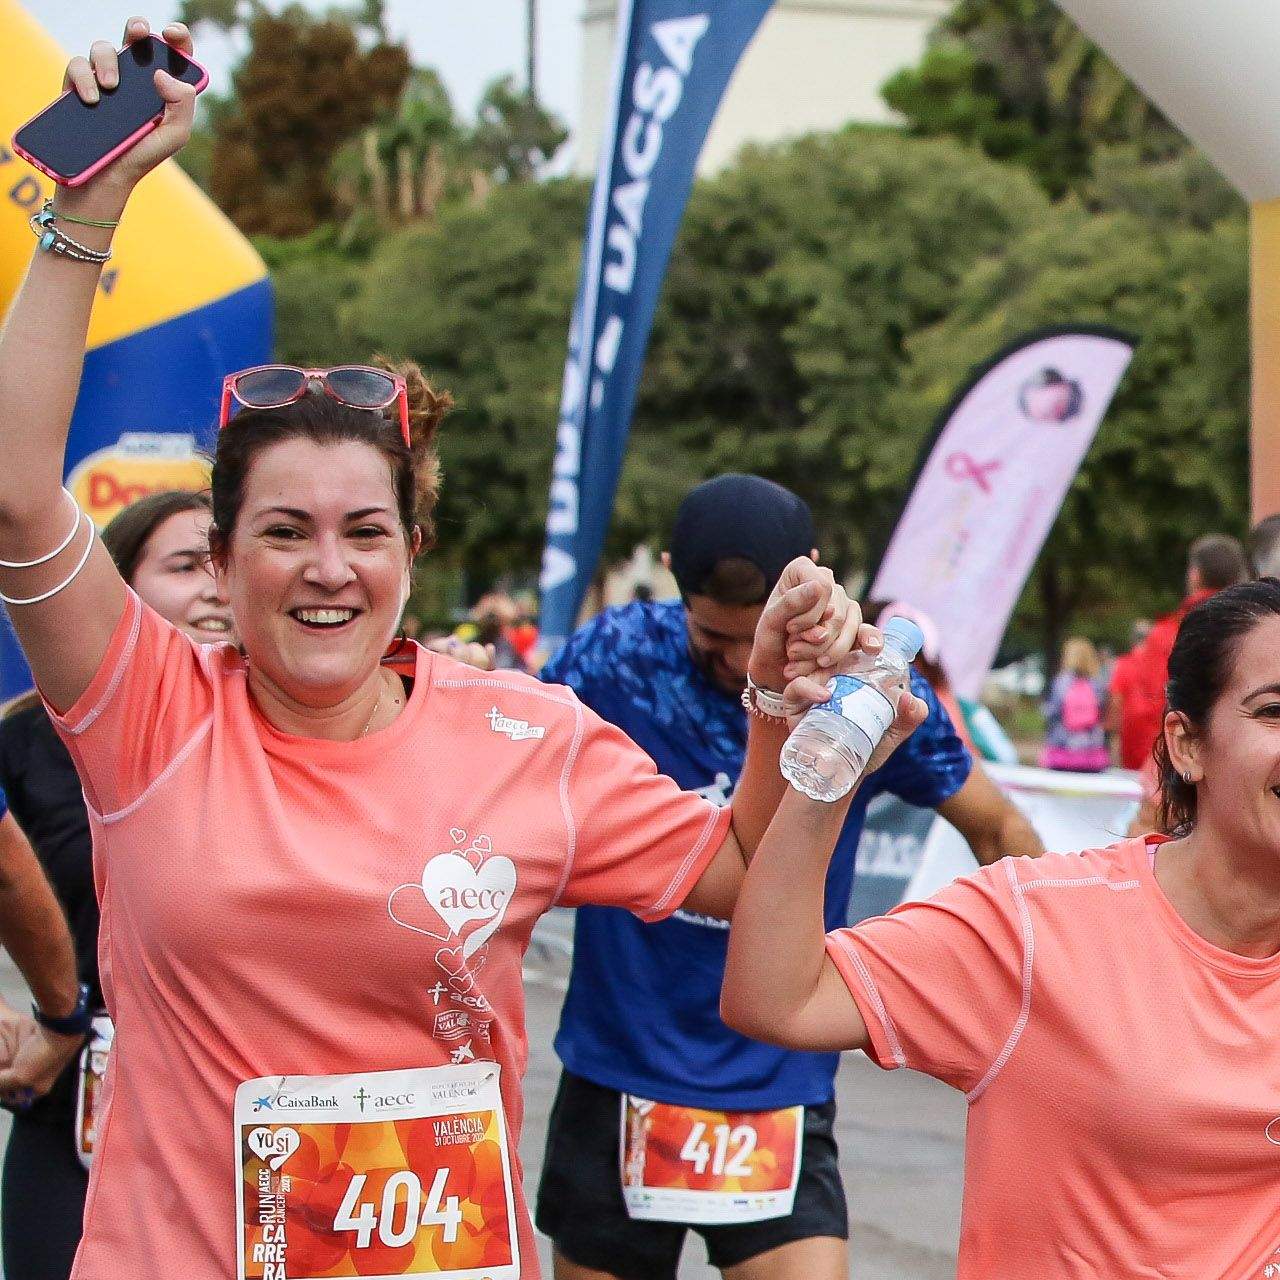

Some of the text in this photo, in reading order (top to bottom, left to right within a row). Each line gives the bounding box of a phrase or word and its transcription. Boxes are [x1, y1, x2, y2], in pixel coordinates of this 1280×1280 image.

[439, 885, 506, 912] aecc
[277, 1094, 339, 1108] CaixaBank
[374, 1091, 415, 1107] aecc
[432, 1116, 484, 1137] VALÈNCIA
[257, 1133, 273, 1148] YO
[434, 1136, 441, 1147] 31
[443, 1133, 472, 1146] OCTUBRE
[679, 1121, 758, 1176] 412
[258, 1168, 271, 1194] AECC
[259, 1194, 276, 1224] RUN
[333, 1167, 463, 1249] 404
[262, 1225, 286, 1243] CA
[252, 1243, 287, 1263] RRE
[263, 1262, 286, 1280] RA
